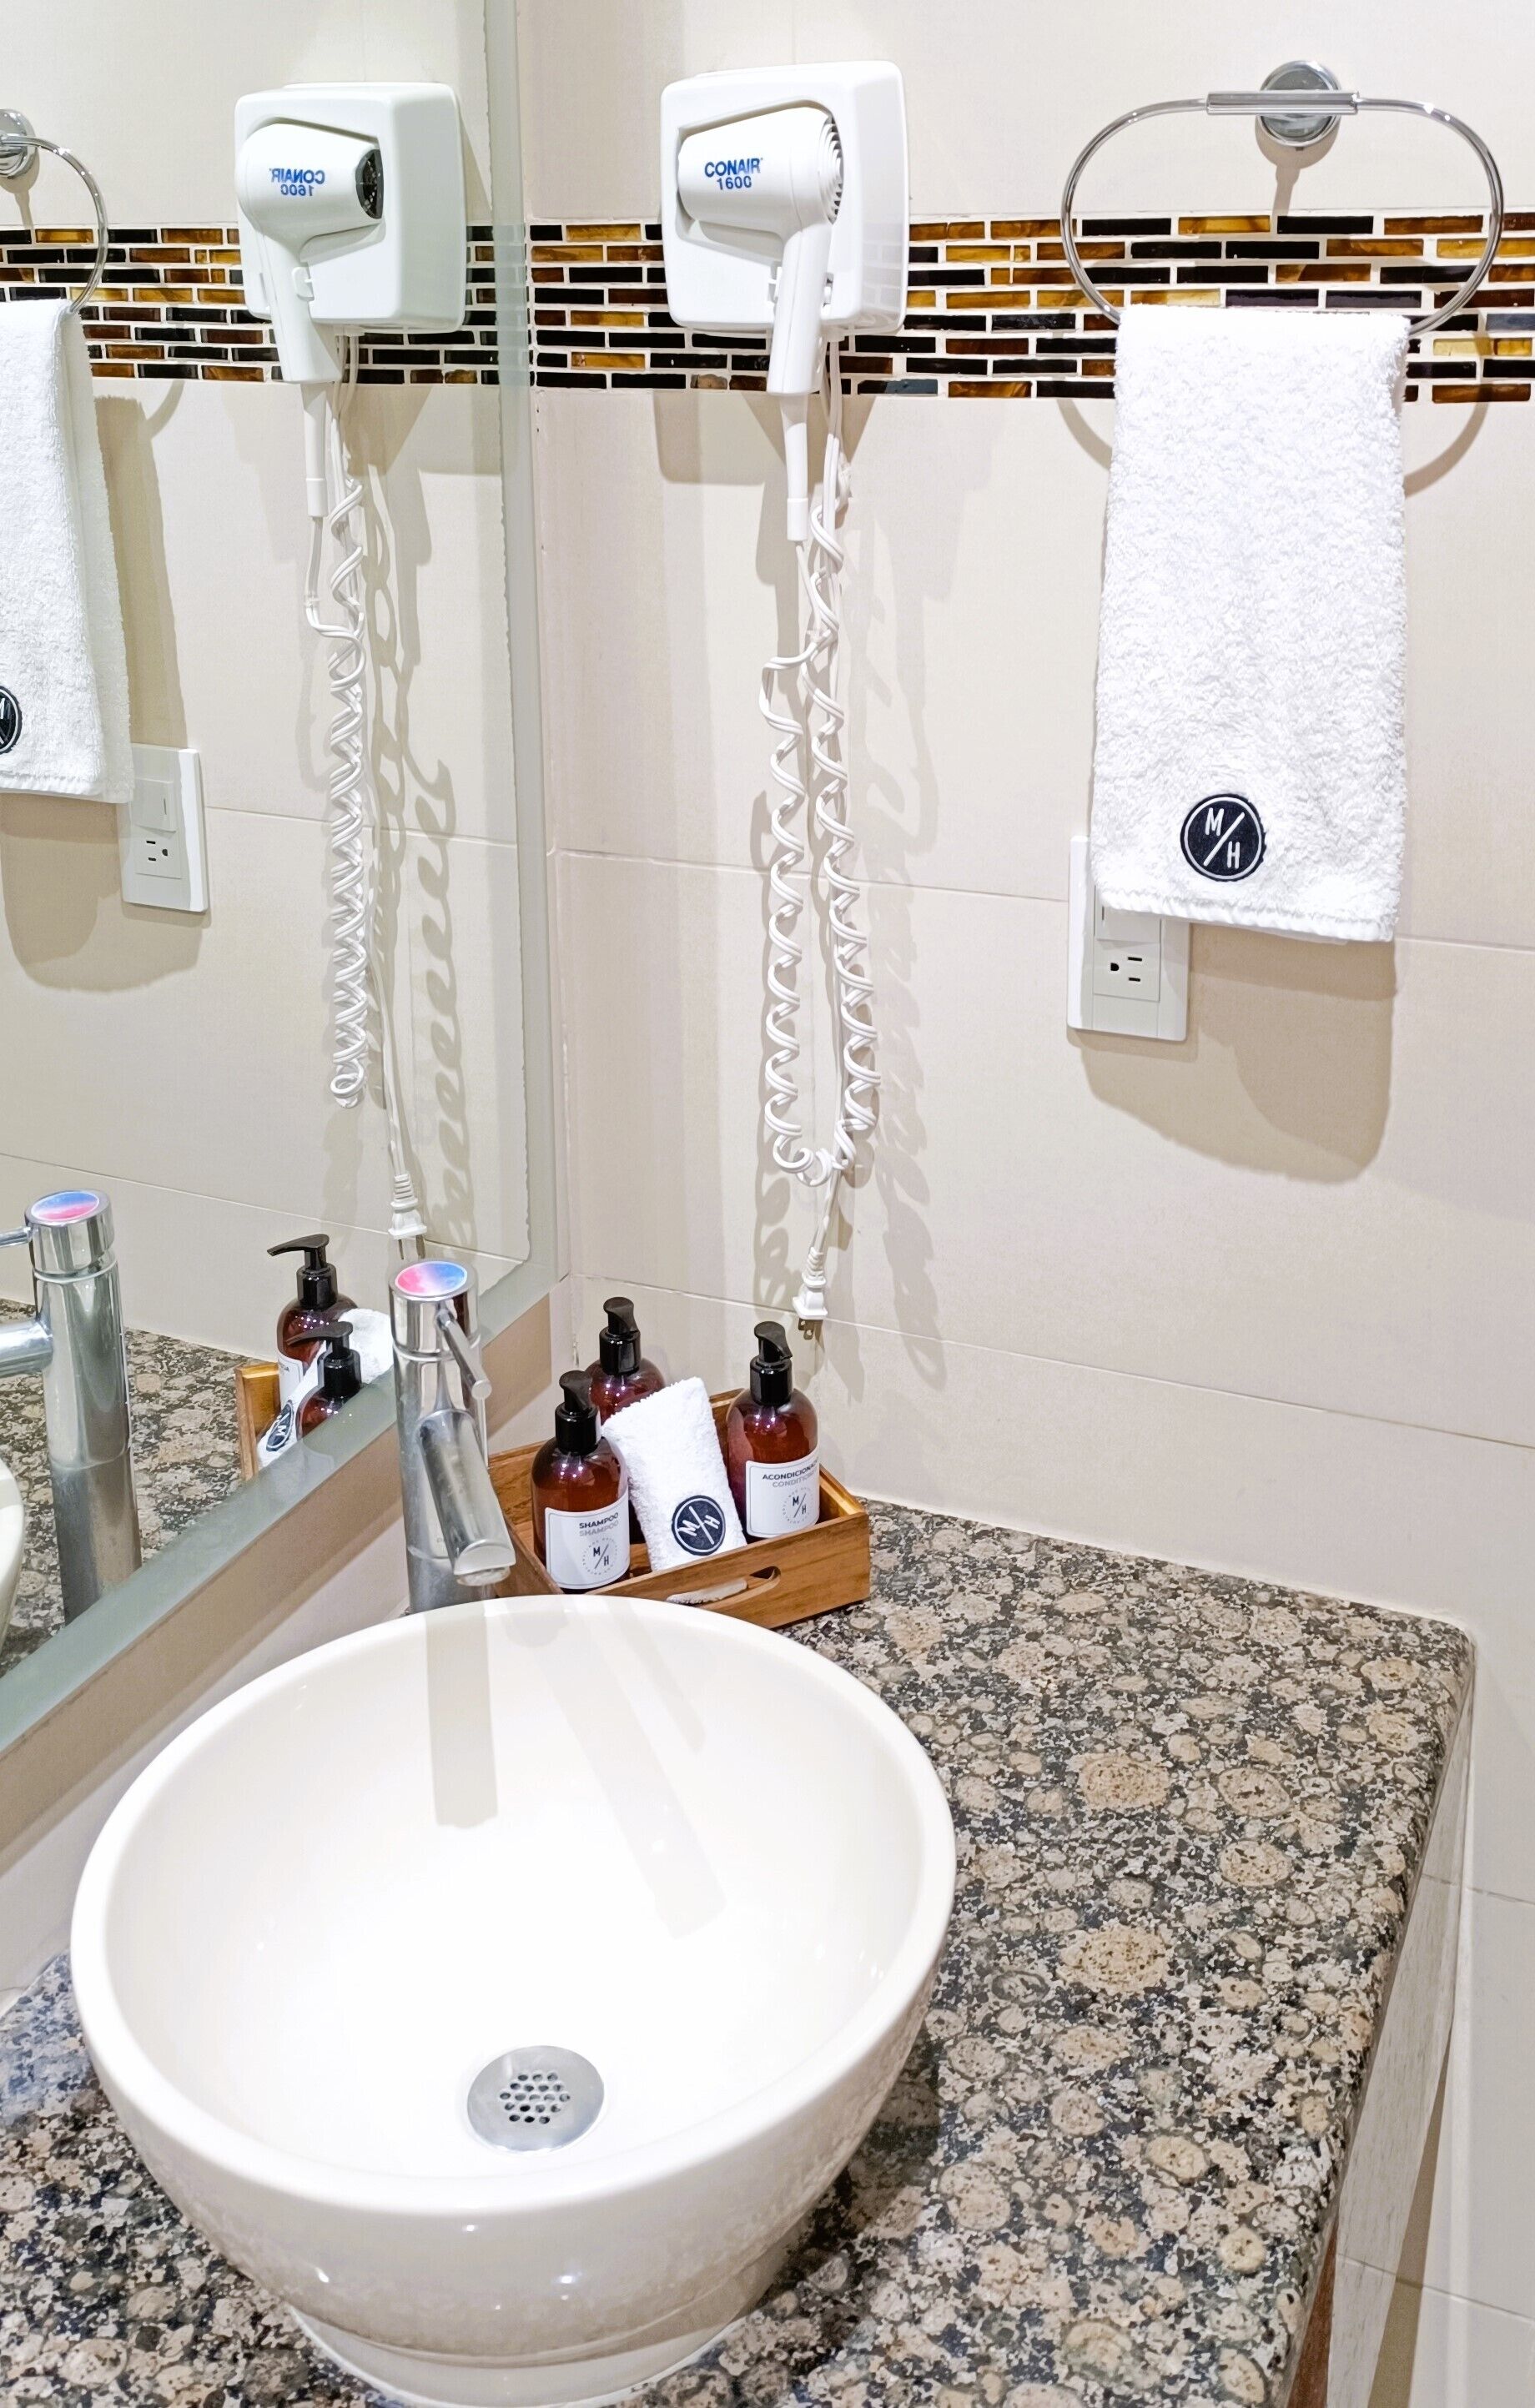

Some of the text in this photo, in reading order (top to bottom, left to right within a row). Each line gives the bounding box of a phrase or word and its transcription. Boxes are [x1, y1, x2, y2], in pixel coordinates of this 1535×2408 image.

[704, 158, 761, 178] CONAIR
[716, 175, 752, 190] 1600
[579, 1512, 619, 1529] SHAMPOO
[579, 1521, 619, 1536] SHAMPOO
